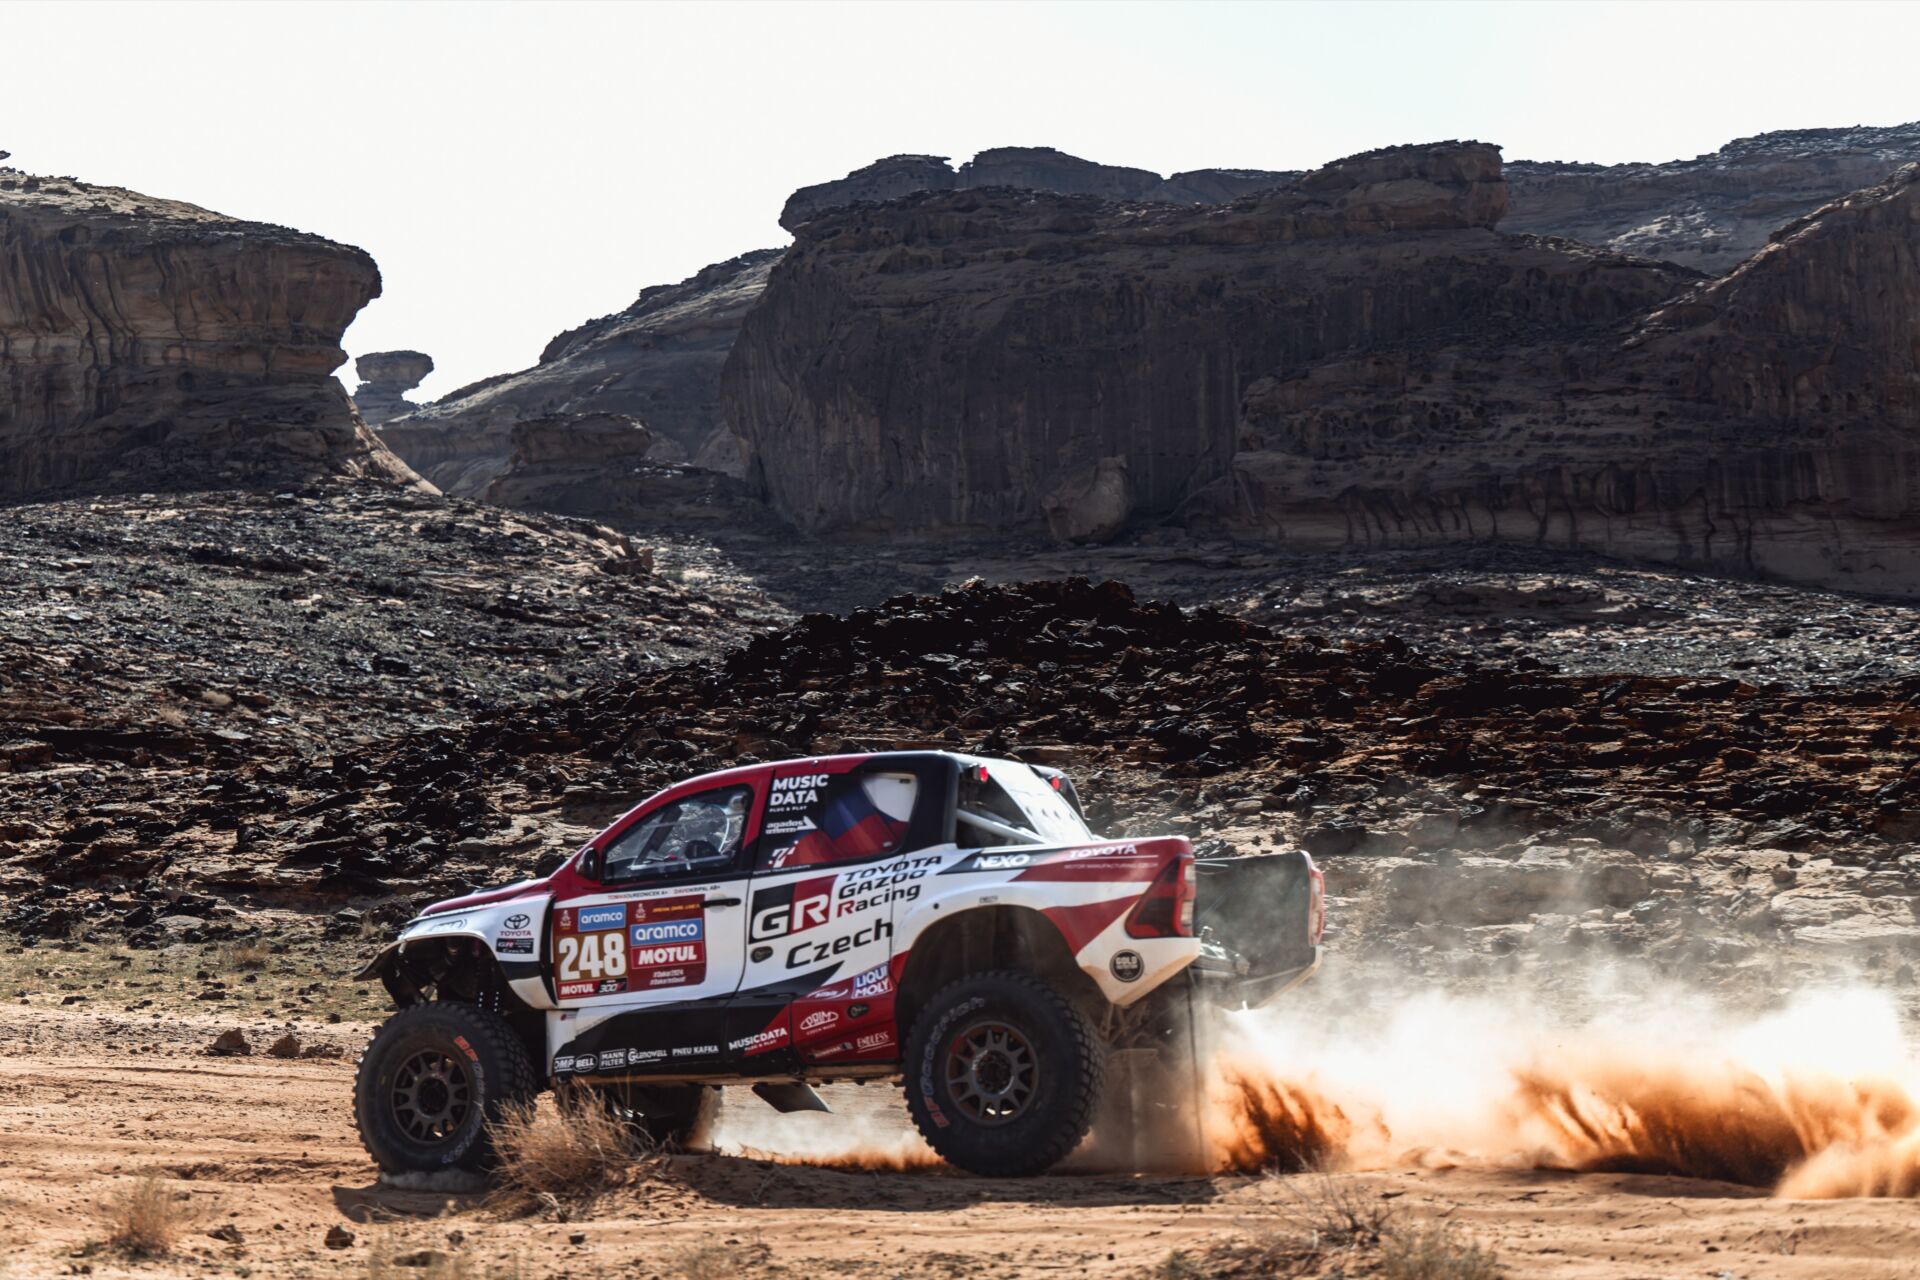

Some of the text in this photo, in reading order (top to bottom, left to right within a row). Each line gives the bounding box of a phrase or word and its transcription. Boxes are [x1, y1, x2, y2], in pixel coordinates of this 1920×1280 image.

[772, 774, 829, 791] MUSIC
[770, 790, 818, 806] DATA
[1068, 844, 1137, 859] TOYOTA
[844, 855, 942, 881] TOYOTA
[972, 853, 1030, 869] NEXO
[838, 870, 928, 899] GAZOO
[836, 884, 921, 918] Racing
[581, 912, 623, 924] aramco
[751, 893, 829, 940] GR
[636, 923, 698, 941] aramco
[786, 918, 894, 970] Czech
[558, 933, 626, 981] 248
[638, 945, 697, 965] MOTUL
[856, 965, 888, 988] LIQUI
[561, 983, 594, 995] MOTUL
[854, 977, 889, 998] MOLY
[728, 1028, 788, 1050] MUSICDATA
[857, 1031, 889, 1048] ENDLESS
[672, 1045, 719, 1056] PNEU KAFKA
[576, 1058, 594, 1068] BELL
[601, 1059, 624, 1068] FILTER
